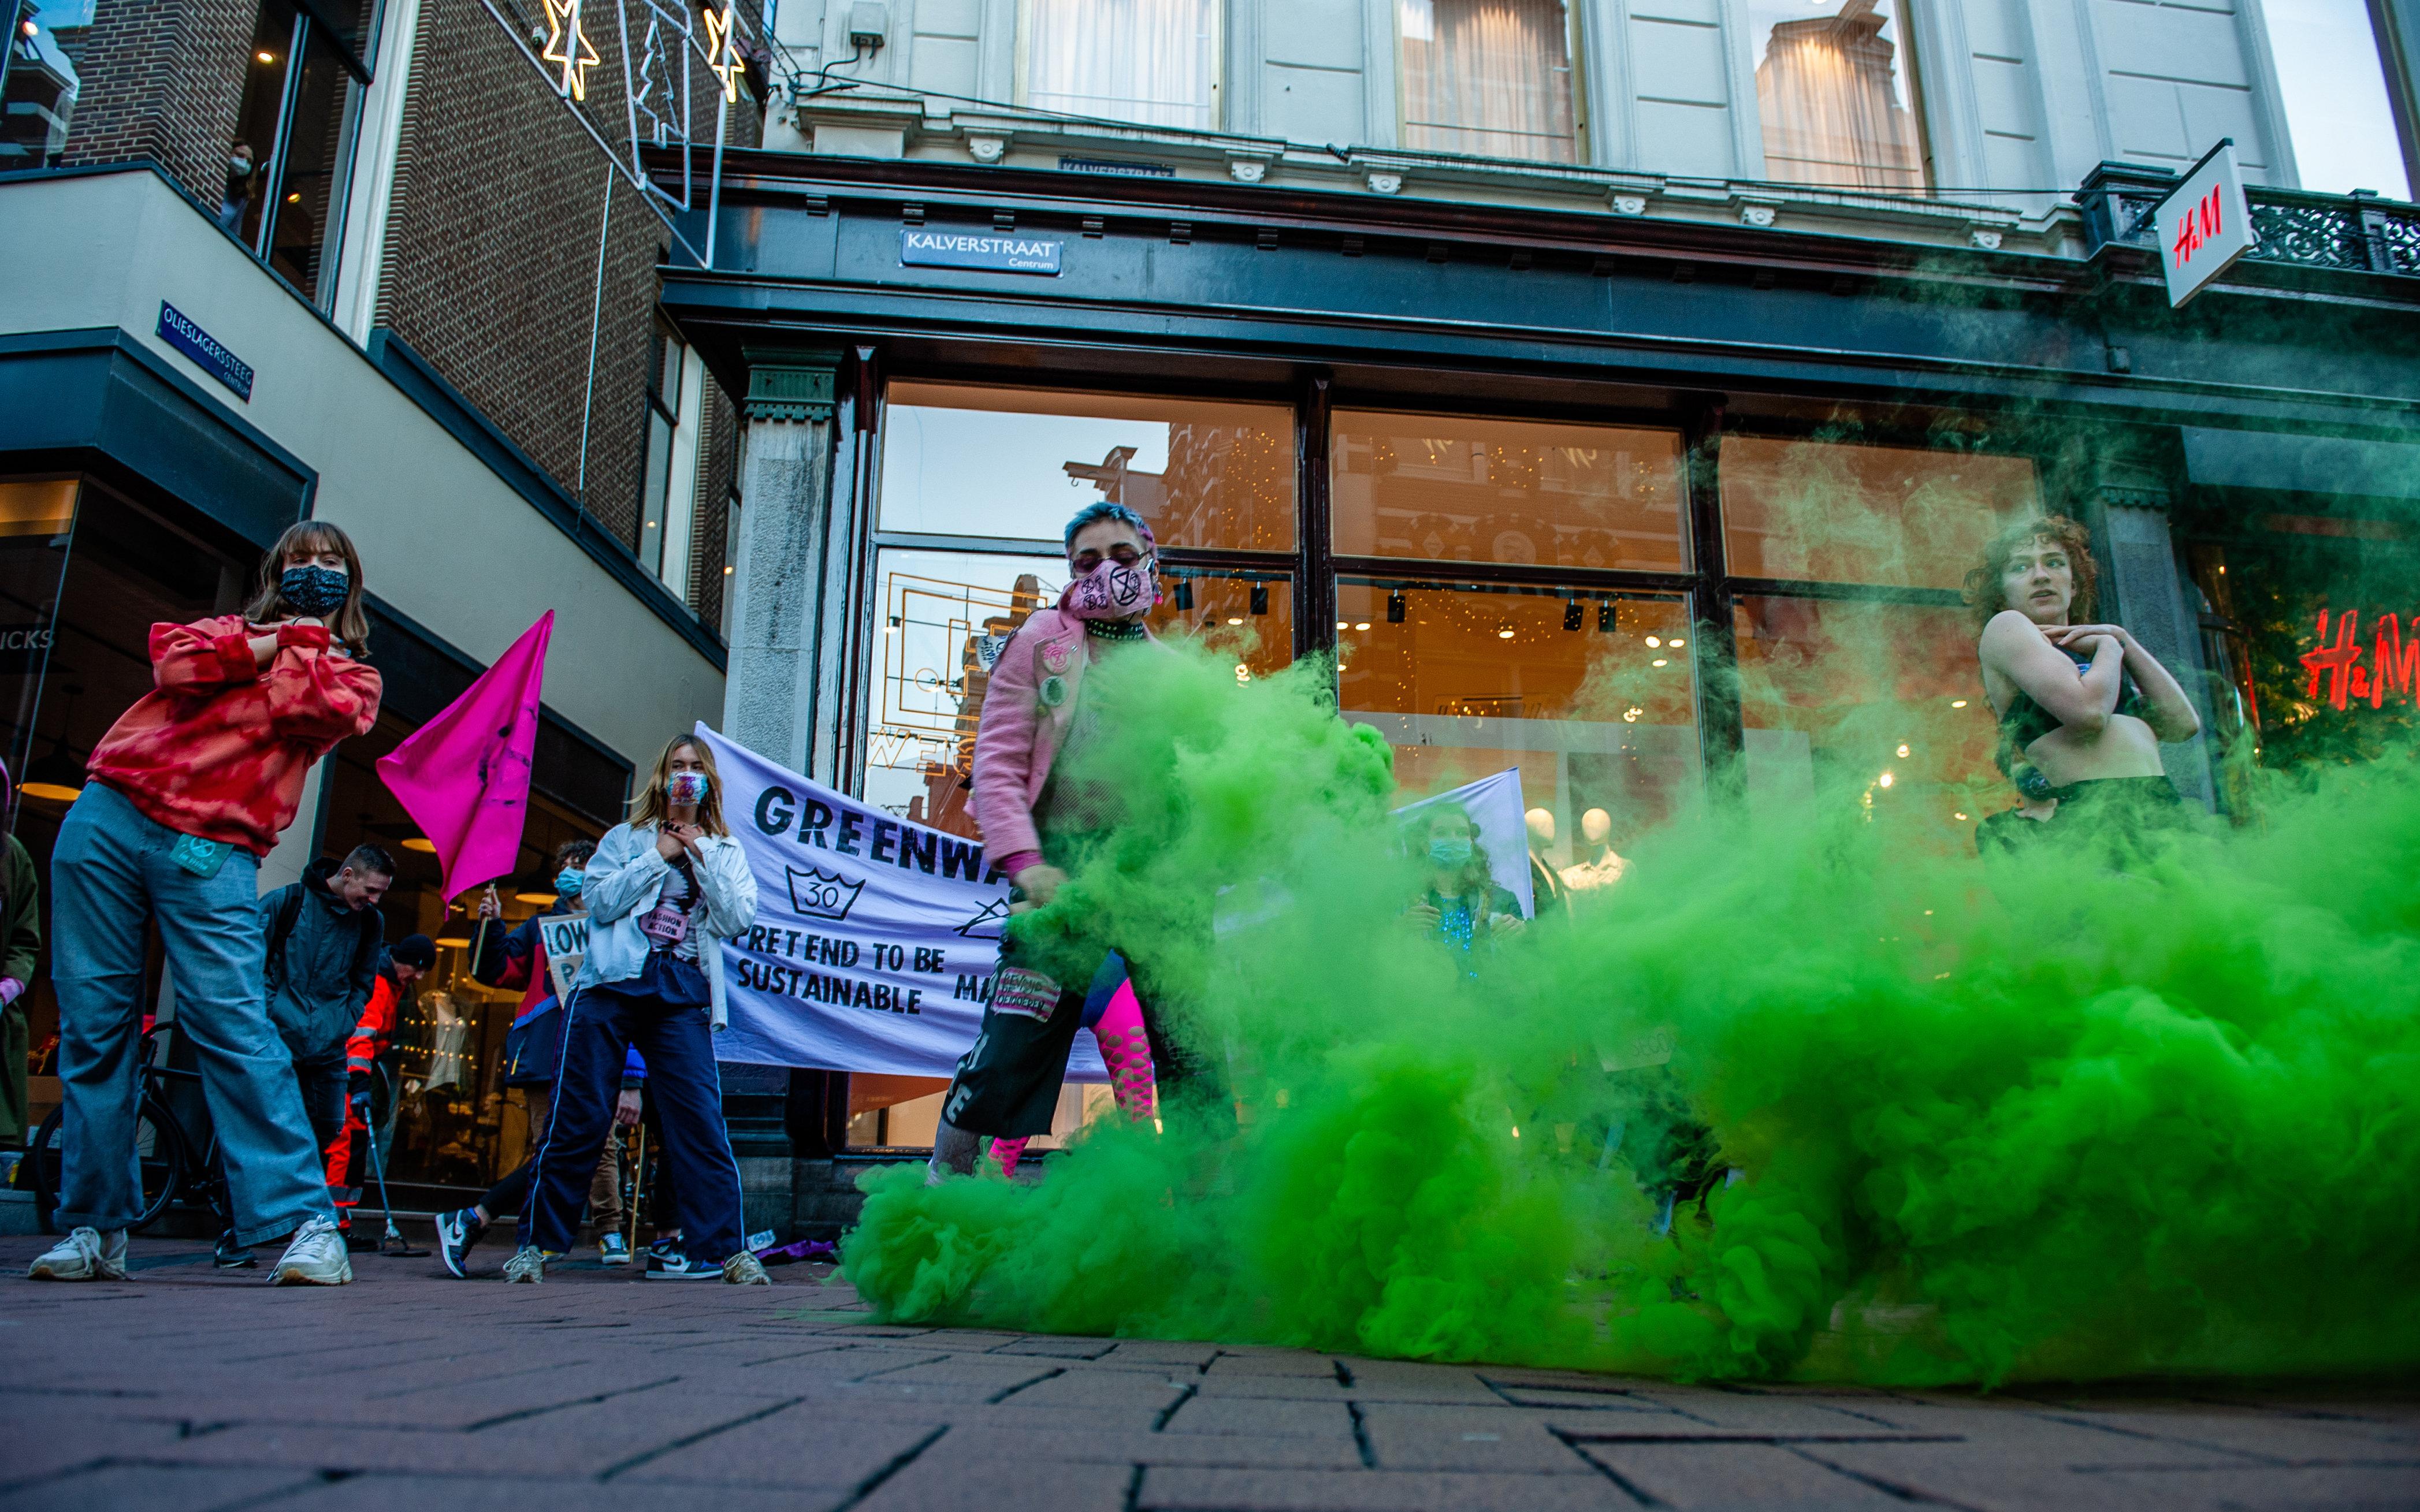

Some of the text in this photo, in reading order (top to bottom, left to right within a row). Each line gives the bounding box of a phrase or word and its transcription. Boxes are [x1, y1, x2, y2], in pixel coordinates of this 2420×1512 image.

[2173, 183, 2222, 269] H&M
[908, 233, 1055, 258] KALVERSTRAAT
[1008, 258, 1054, 270] Centrum
[163, 307, 253, 385] OLIESLAGERSSTEEG
[223, 371, 250, 396] CENTRUM
[2299, 608, 2420, 712] H&M
[804, 881, 839, 909] 30
[647, 912, 682, 928] FASHION
[647, 922, 678, 936] ACTION
[873, 942, 904, 972] TO
[913, 946, 946, 974] BE
[737, 958, 923, 1015] SUSTAINABLE
